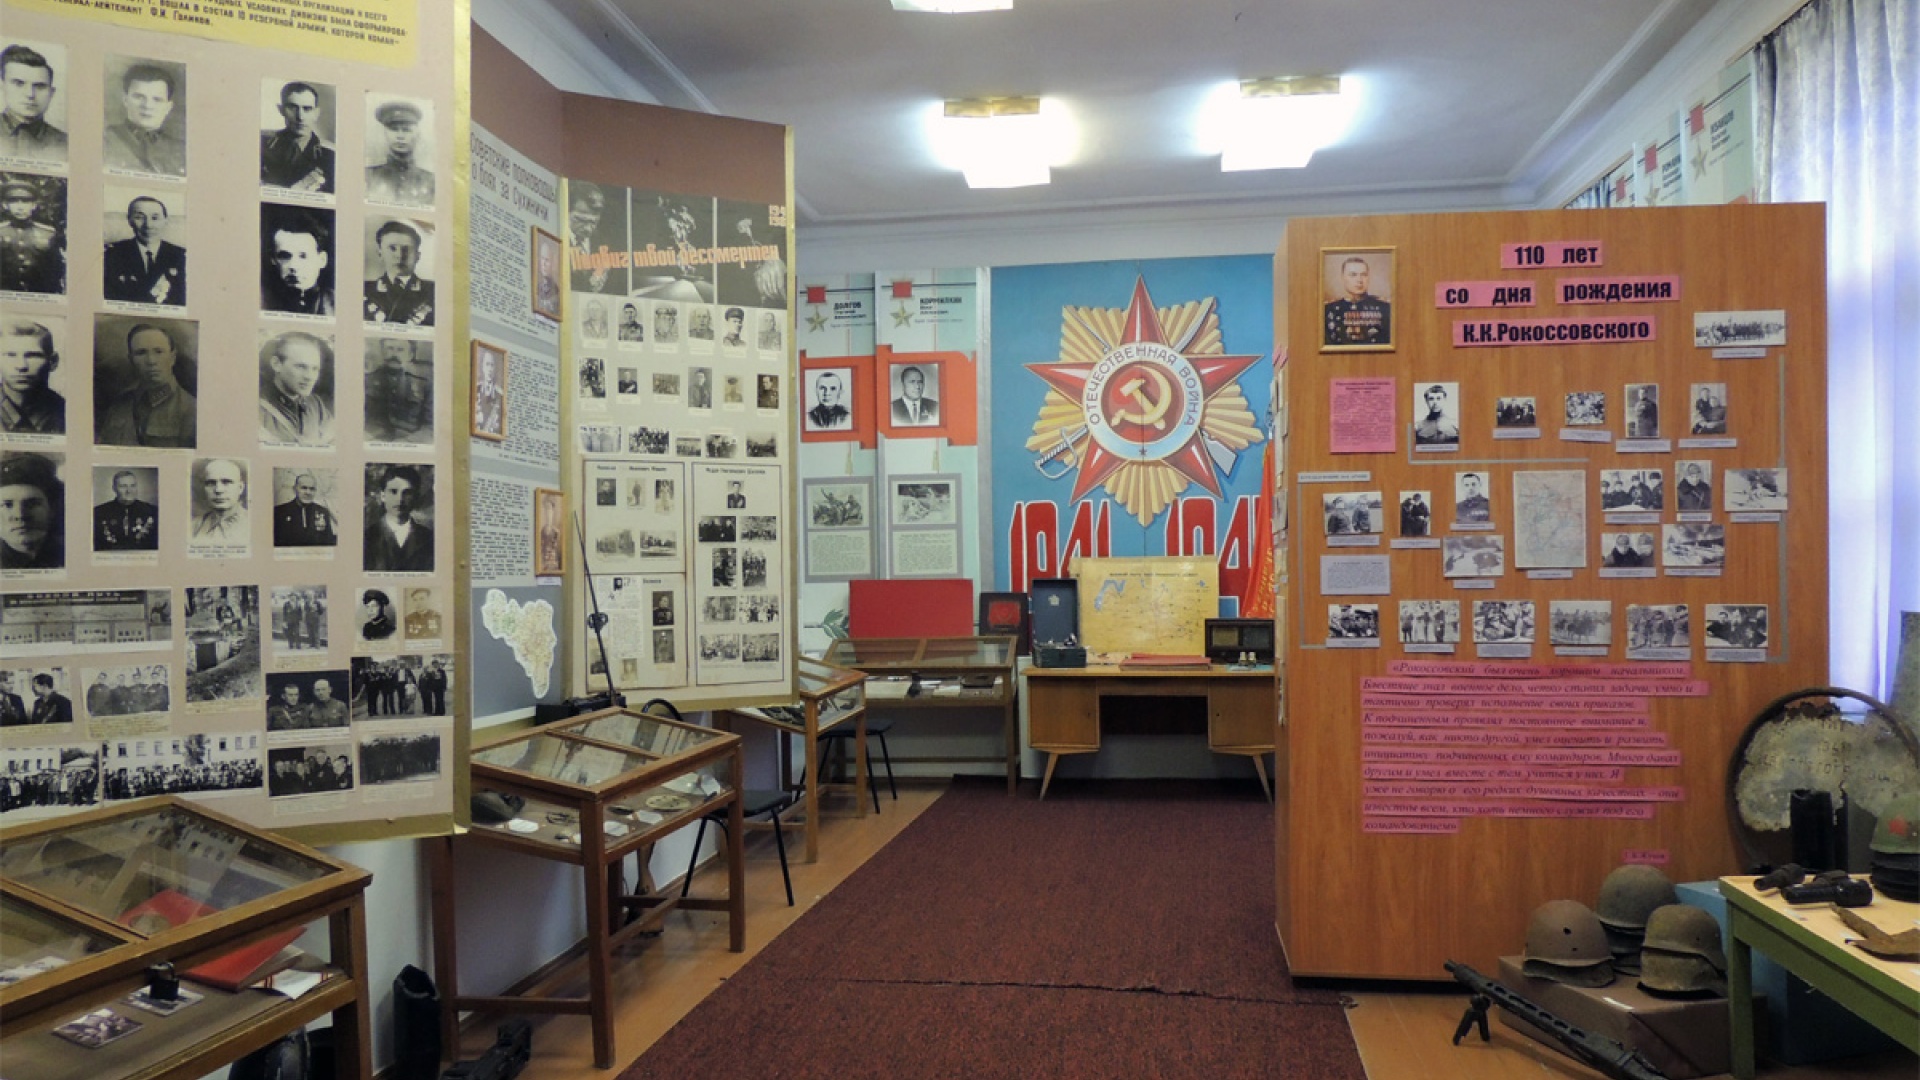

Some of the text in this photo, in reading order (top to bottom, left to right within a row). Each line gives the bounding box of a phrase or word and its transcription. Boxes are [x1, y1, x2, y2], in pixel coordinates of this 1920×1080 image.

[633, 243, 676, 267] твой
[1515, 246, 1598, 265] 110 лет
[1446, 281, 1672, 306] со дня рождения
[1463, 322, 1649, 343] К.К.Рокоссовского
[1177, 366, 1200, 426] ВОЙНА
